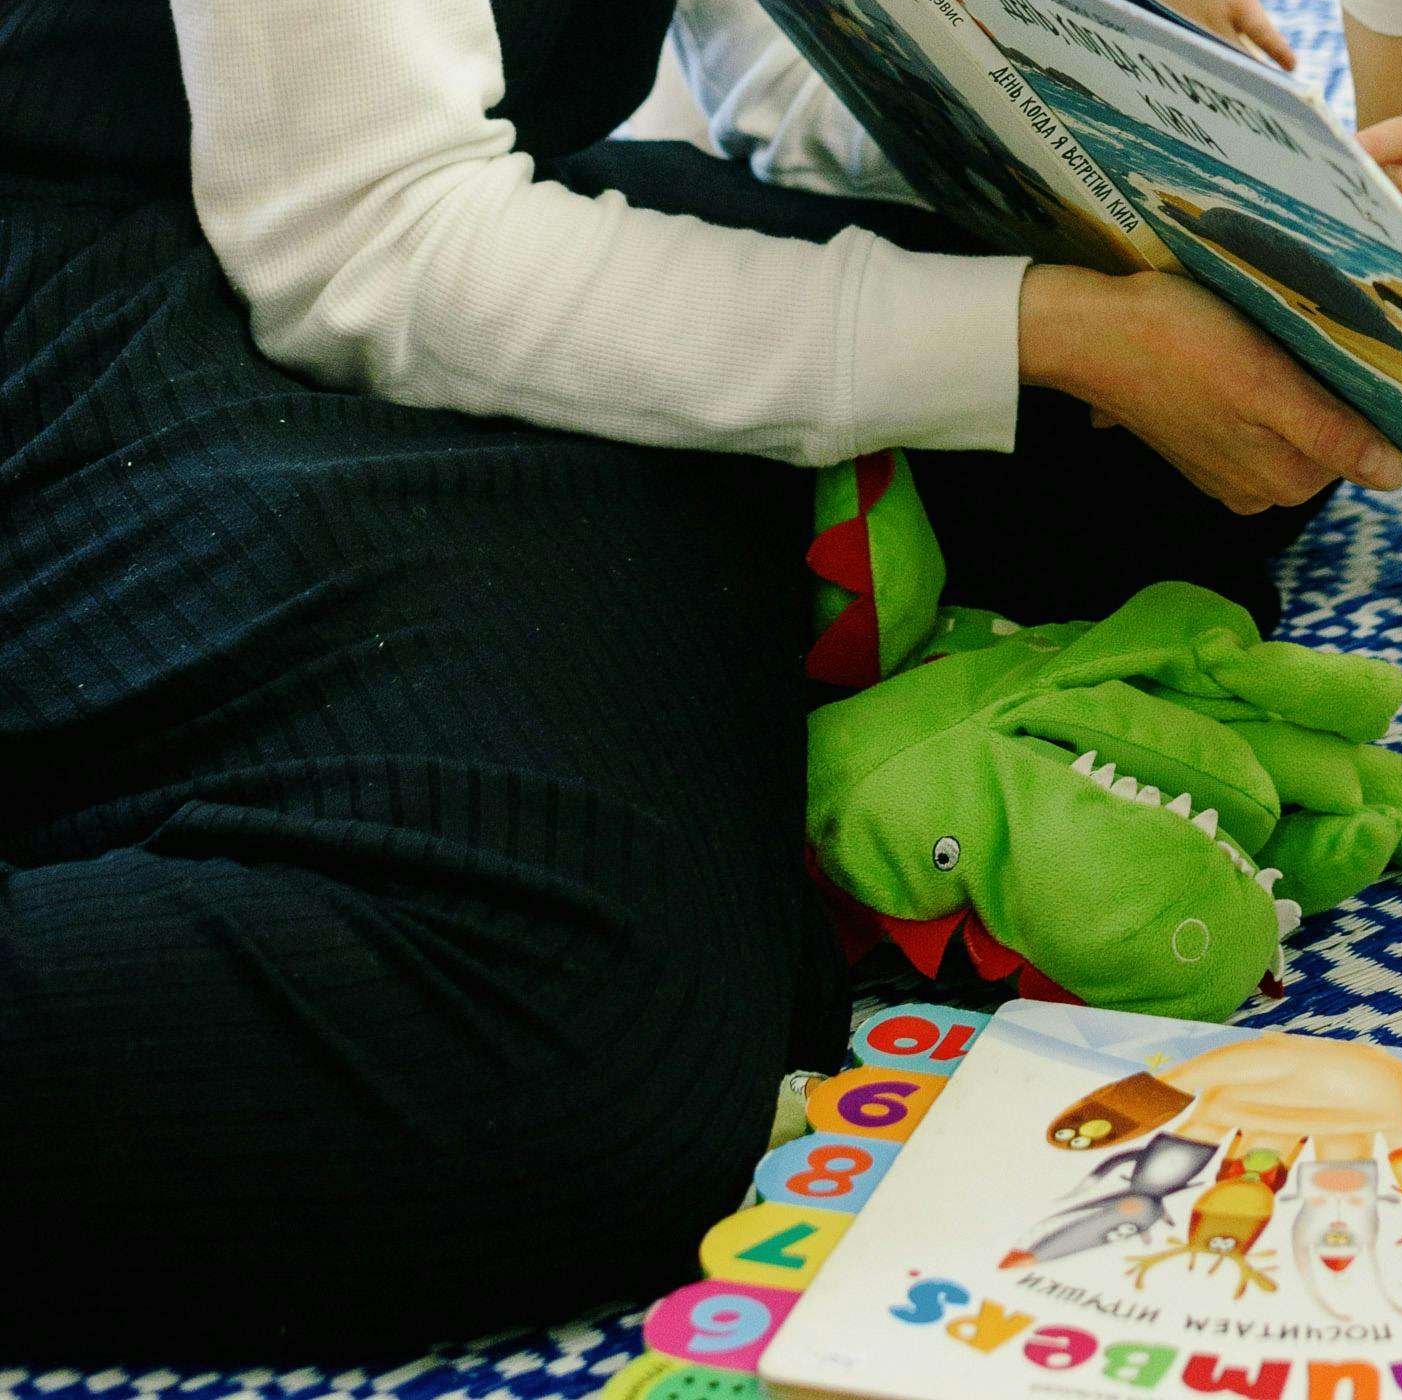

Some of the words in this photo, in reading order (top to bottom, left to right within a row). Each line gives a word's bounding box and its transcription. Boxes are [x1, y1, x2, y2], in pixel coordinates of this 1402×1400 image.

[989, 65, 1023, 104] ДЕНЬ,
[1022, 96, 1056, 138] КОГДА
[1051, 135, 1067, 151] Я
[1063, 147, 1113, 203] ВСТРЕТИЛ
[1107, 200, 1139, 234] КИТА
[867, 1015, 976, 1061] 10
[837, 1081, 921, 1127] 9
[786, 1144, 874, 1197] 8
[736, 1223, 819, 1269] 7
[1017, 1271, 1161, 1322] ИГРУШКИ
[688, 1294, 771, 1353] 6
[1185, 1314, 1395, 1343] ПОСЧИТАЕМ
